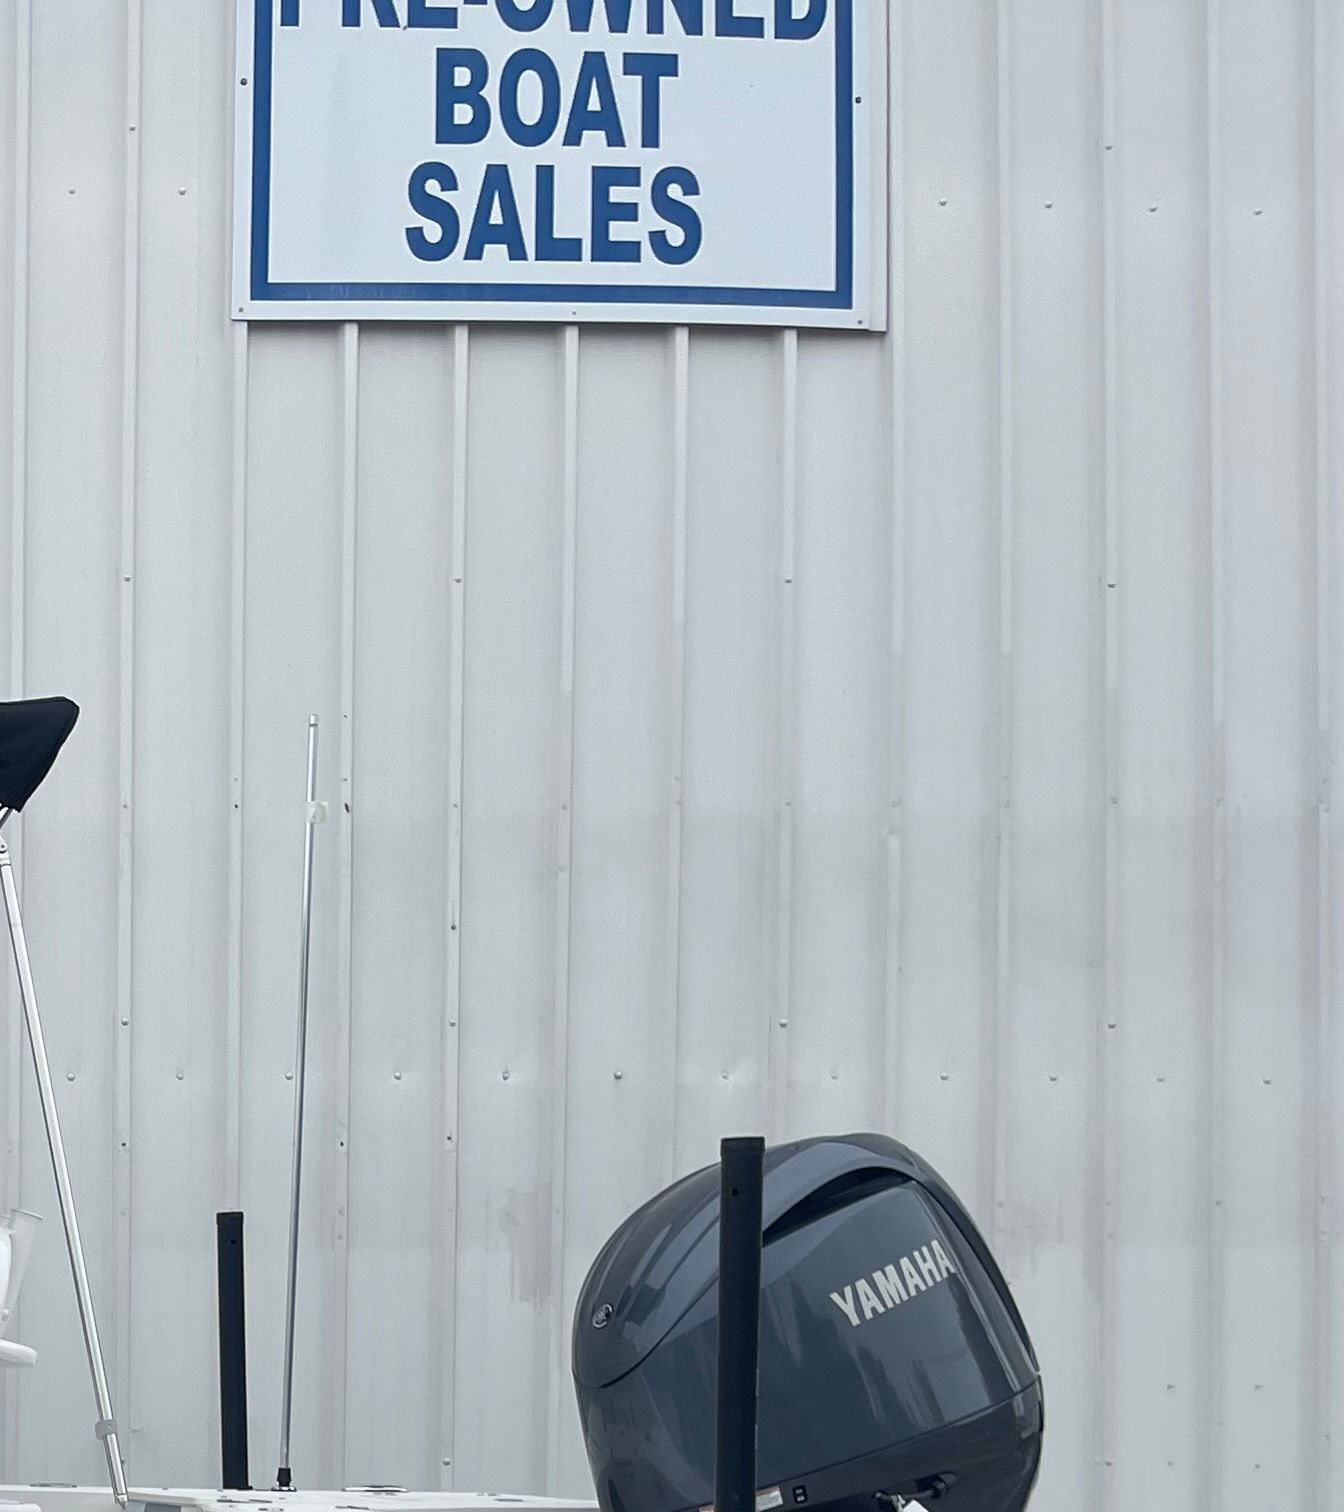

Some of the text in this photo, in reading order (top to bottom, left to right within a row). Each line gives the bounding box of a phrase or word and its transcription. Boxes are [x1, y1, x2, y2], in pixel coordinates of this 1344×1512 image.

[435, 48, 679, 148] BOAT
[405, 161, 703, 265] SALES
[829, 1238, 956, 1327] YAMAHA
